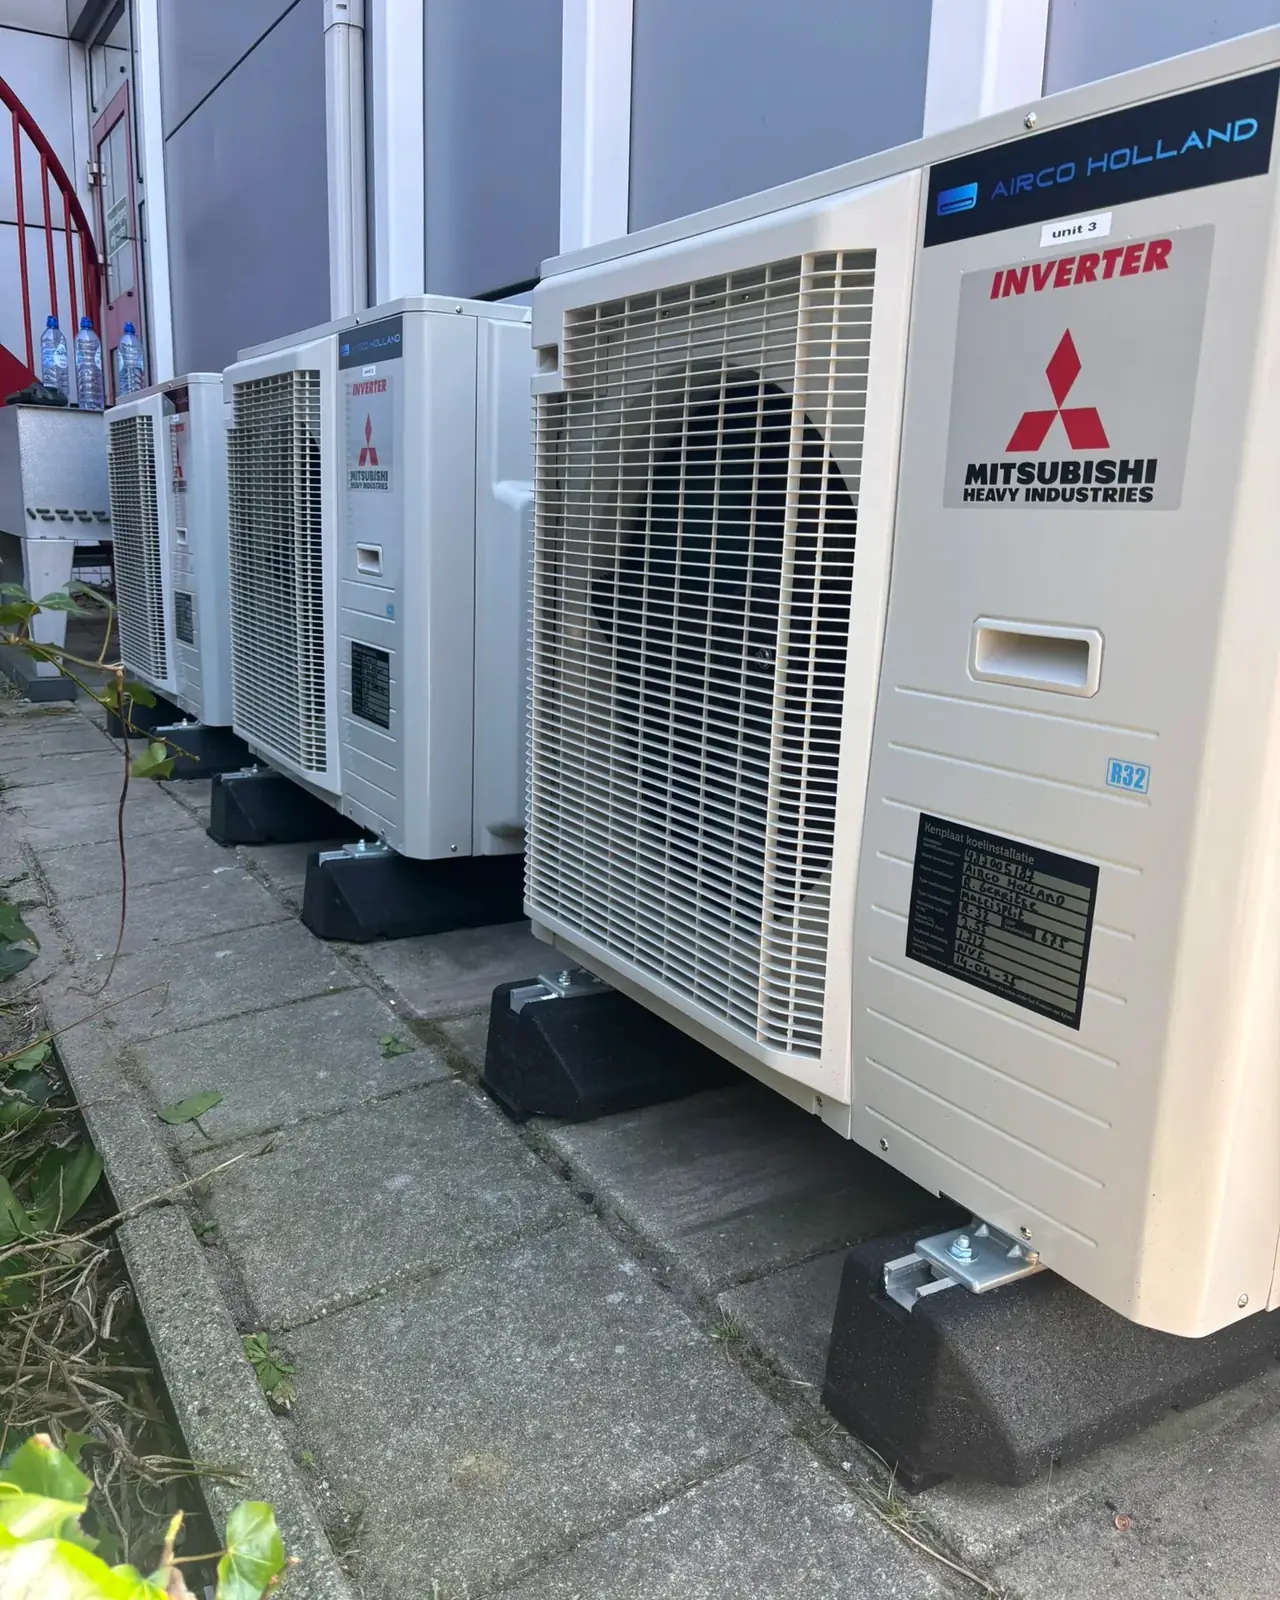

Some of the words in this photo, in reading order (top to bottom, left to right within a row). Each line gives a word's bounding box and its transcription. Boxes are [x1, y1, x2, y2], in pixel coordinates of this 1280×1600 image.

[991, 163, 1075, 200] AIRCO
[1087, 118, 1258, 177] HOLLAND
[1052, 225, 1083, 239] unit
[1088, 221, 1098, 232] 3
[990, 239, 1173, 300] INVERTER
[353, 379, 387, 396] INVERTER
[350, 470, 389, 482] MITSUBISHI
[964, 458, 1158, 486] MITSUBISHI
[963, 488, 1020, 502] HEAVY
[1024, 486, 1154, 504] INDUSTRIES
[1110, 762, 1145, 789] R32
[925, 822, 964, 843] Kenplaat
[966, 834, 1035, 866] koelinstallatie
